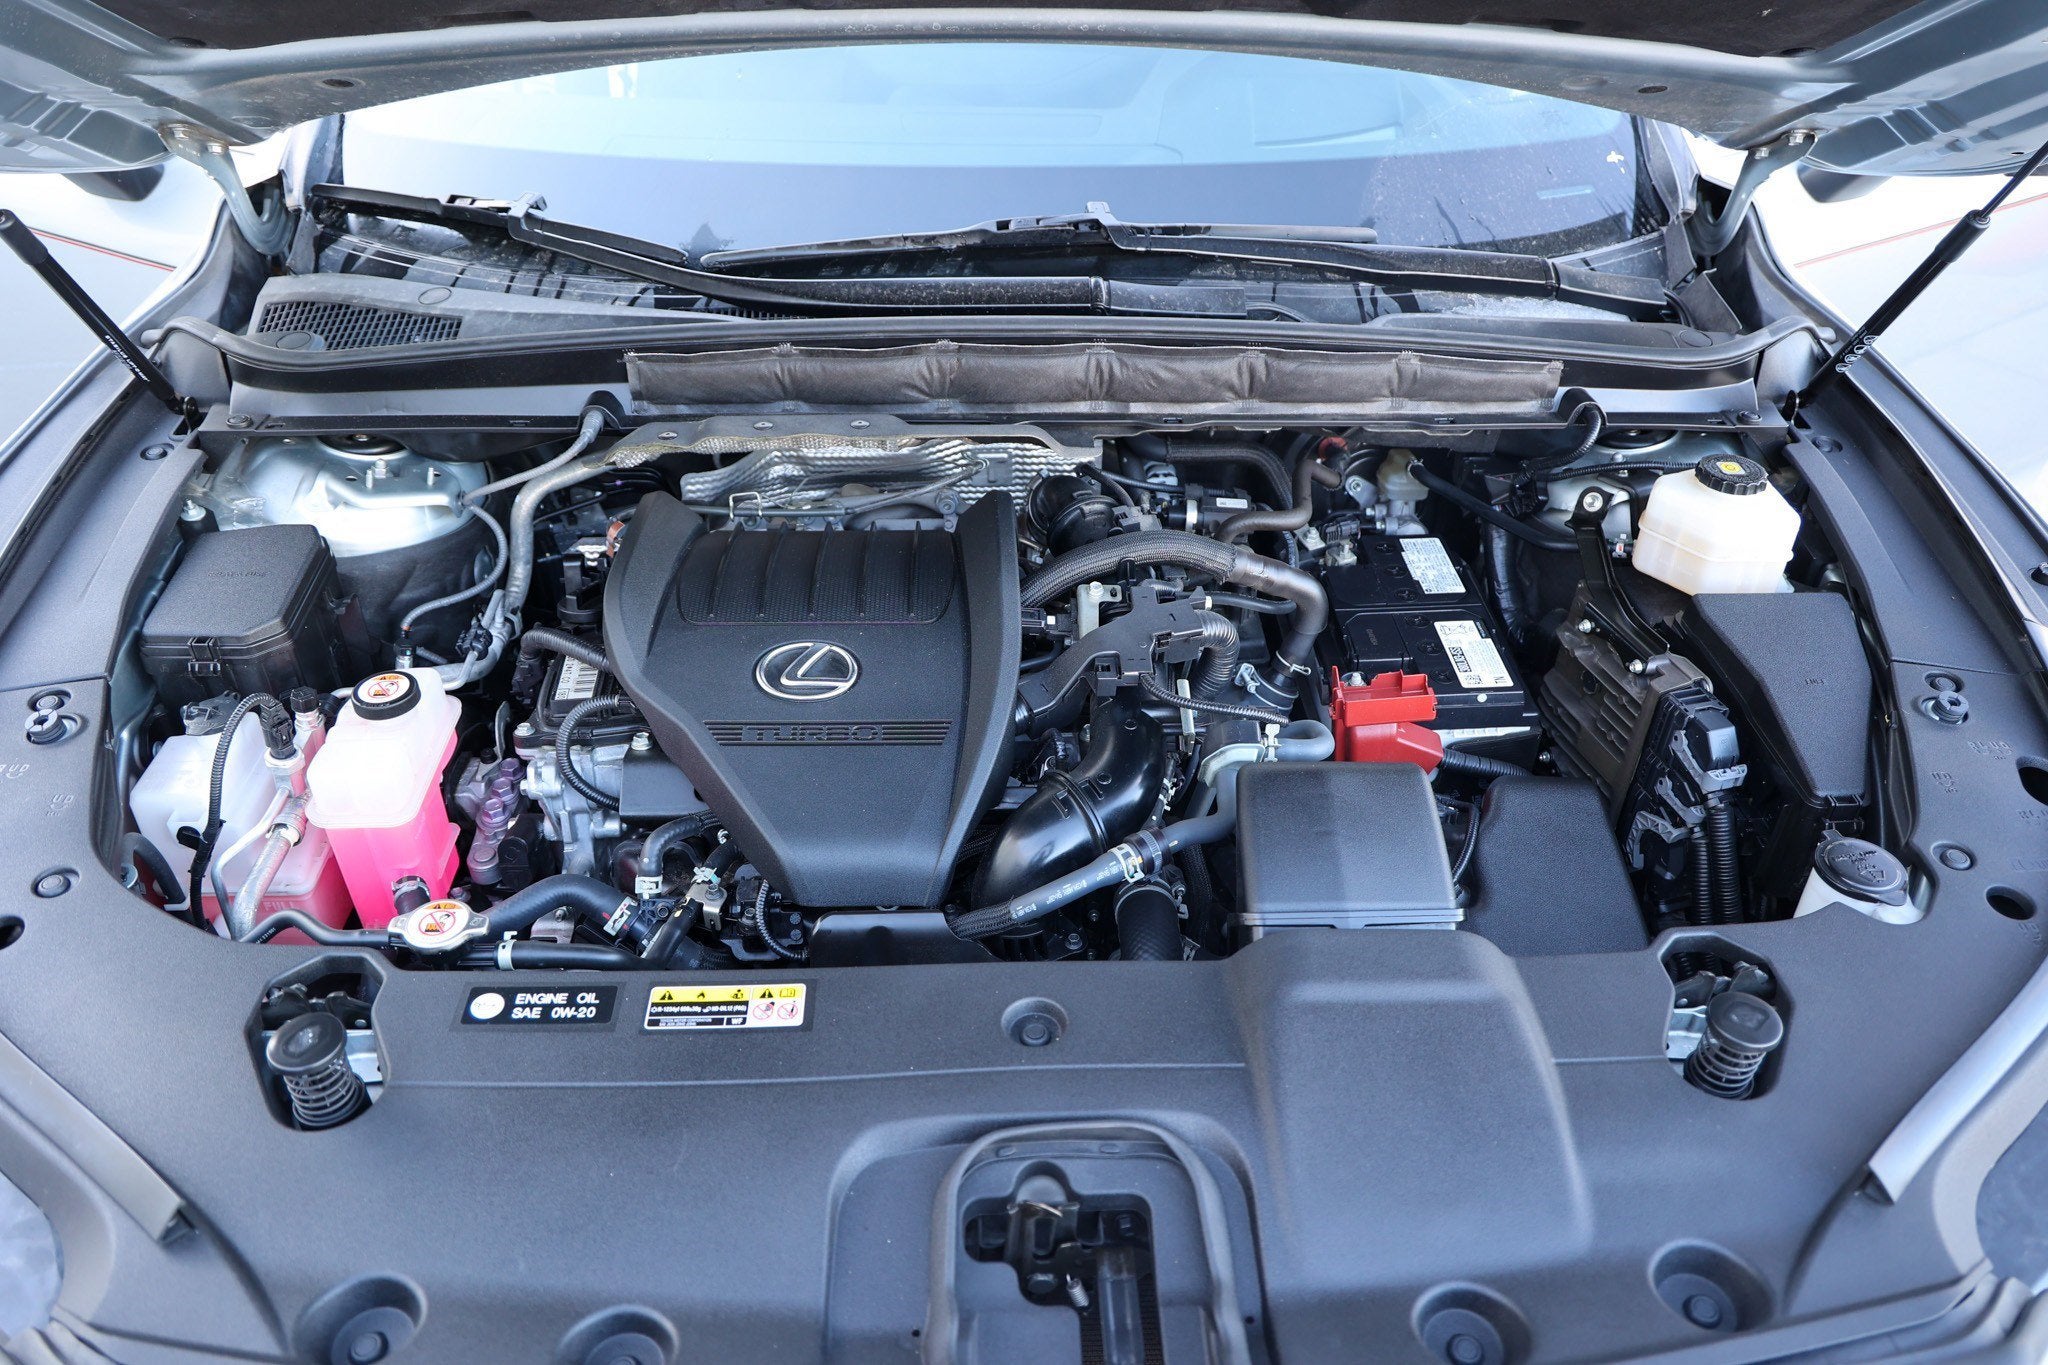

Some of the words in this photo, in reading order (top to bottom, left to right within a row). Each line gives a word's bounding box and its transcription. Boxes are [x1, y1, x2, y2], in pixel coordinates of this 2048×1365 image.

[746, 725, 879, 741] TURBO
[515, 992, 569, 1004] ENGINE
[576, 992, 600, 1004] OIL
[511, 1007, 542, 1019] SAE
[551, 1006, 597, 1018] 0W-20
